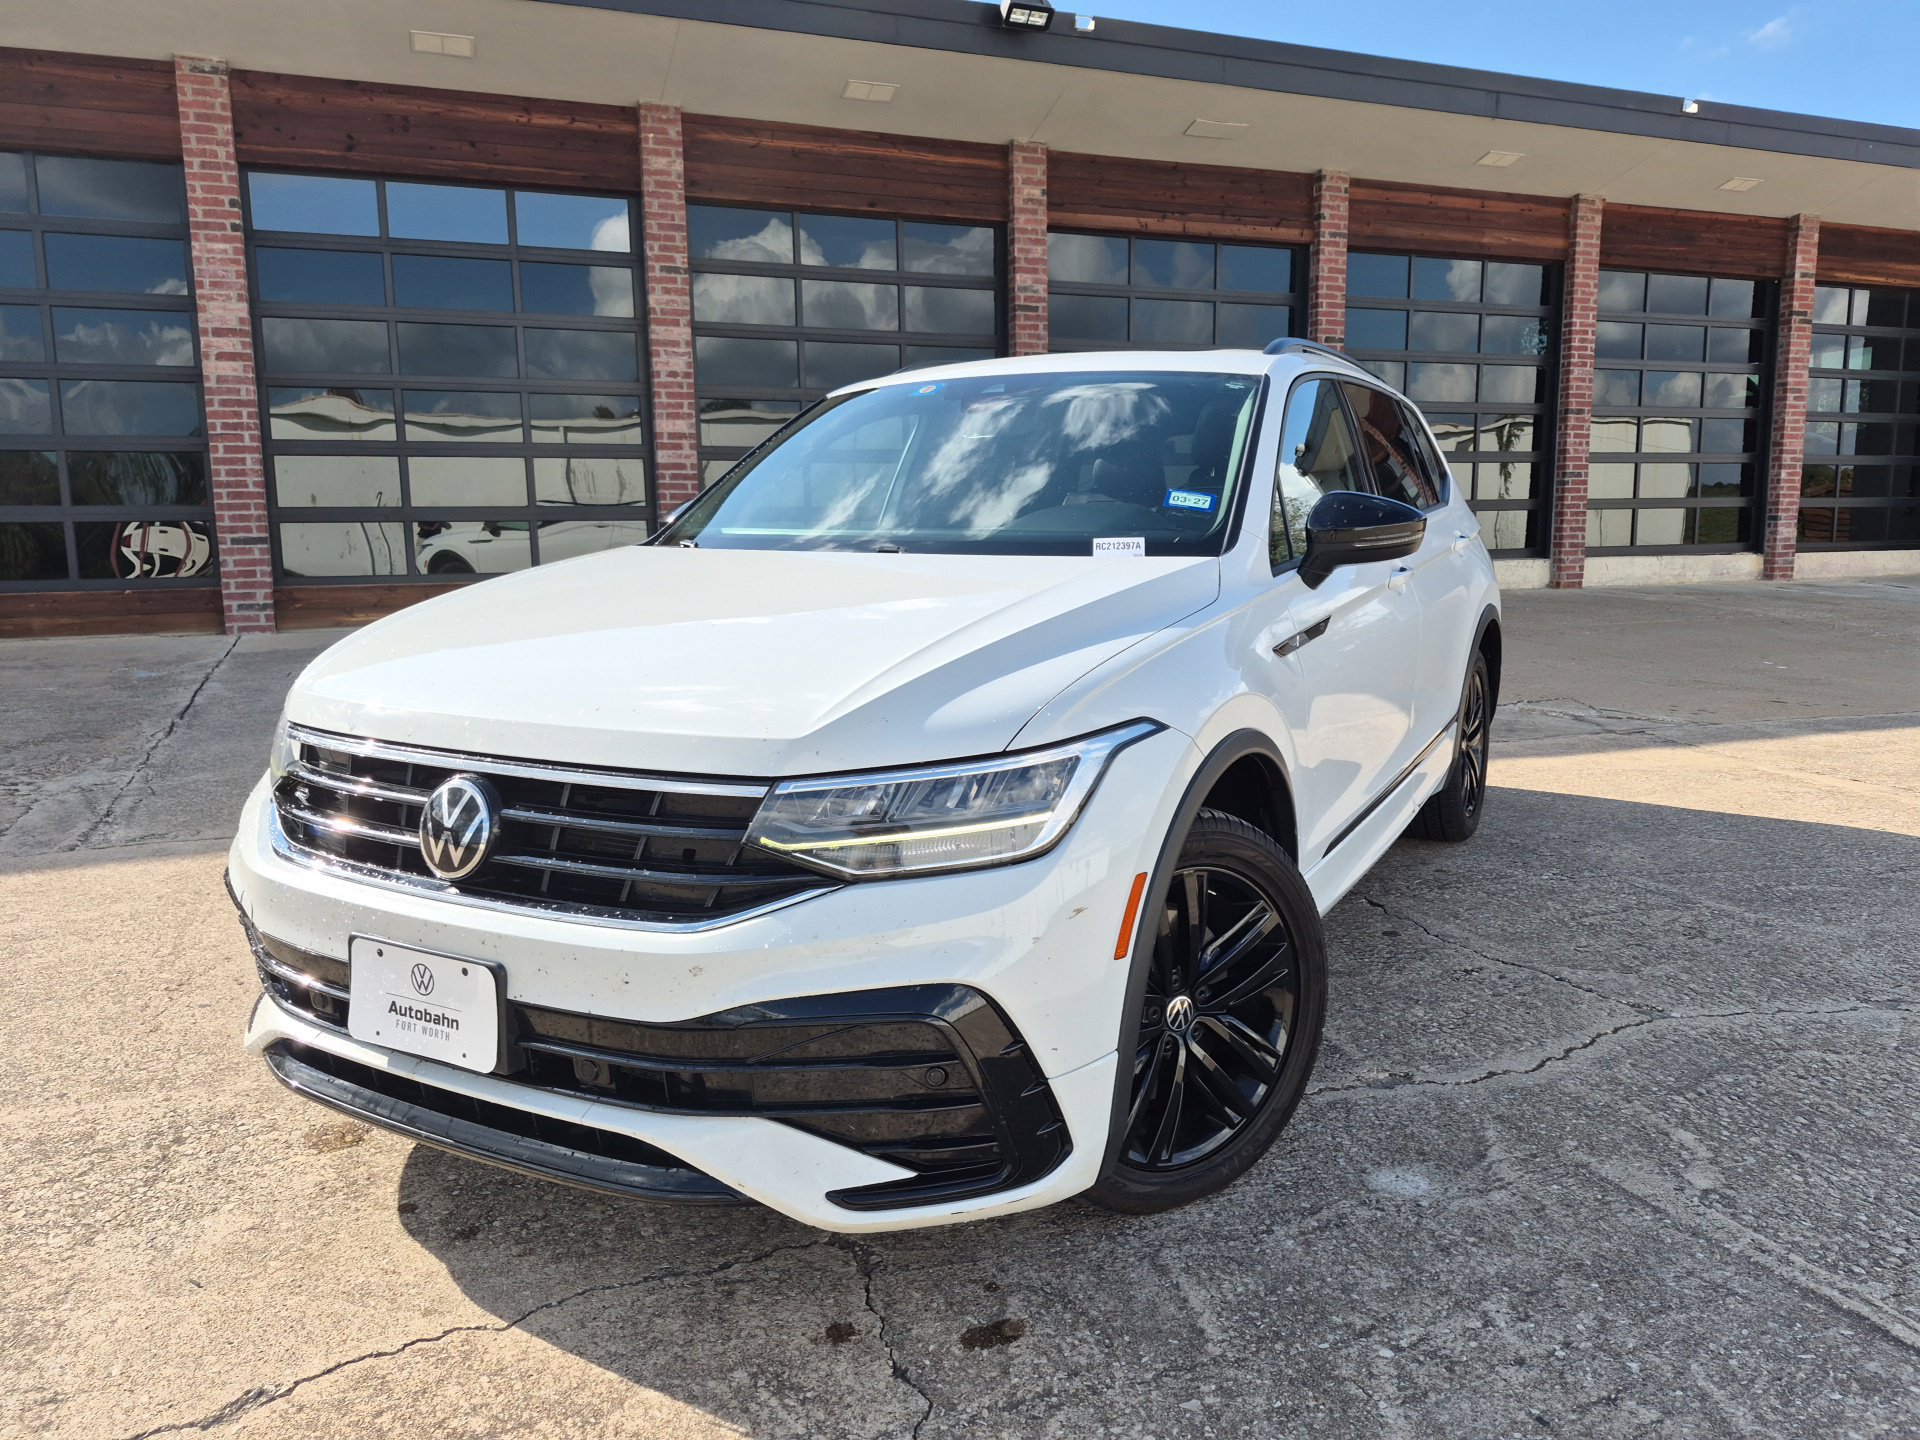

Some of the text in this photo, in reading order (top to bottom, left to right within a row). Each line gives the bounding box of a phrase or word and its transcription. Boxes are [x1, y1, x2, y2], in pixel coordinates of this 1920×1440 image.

[1095, 541, 1142, 550] RC212397A
[421, 781, 488, 875] VW
[388, 1000, 459, 1031] Autobahn
[395, 1019, 450, 1041] FORT WORTH
